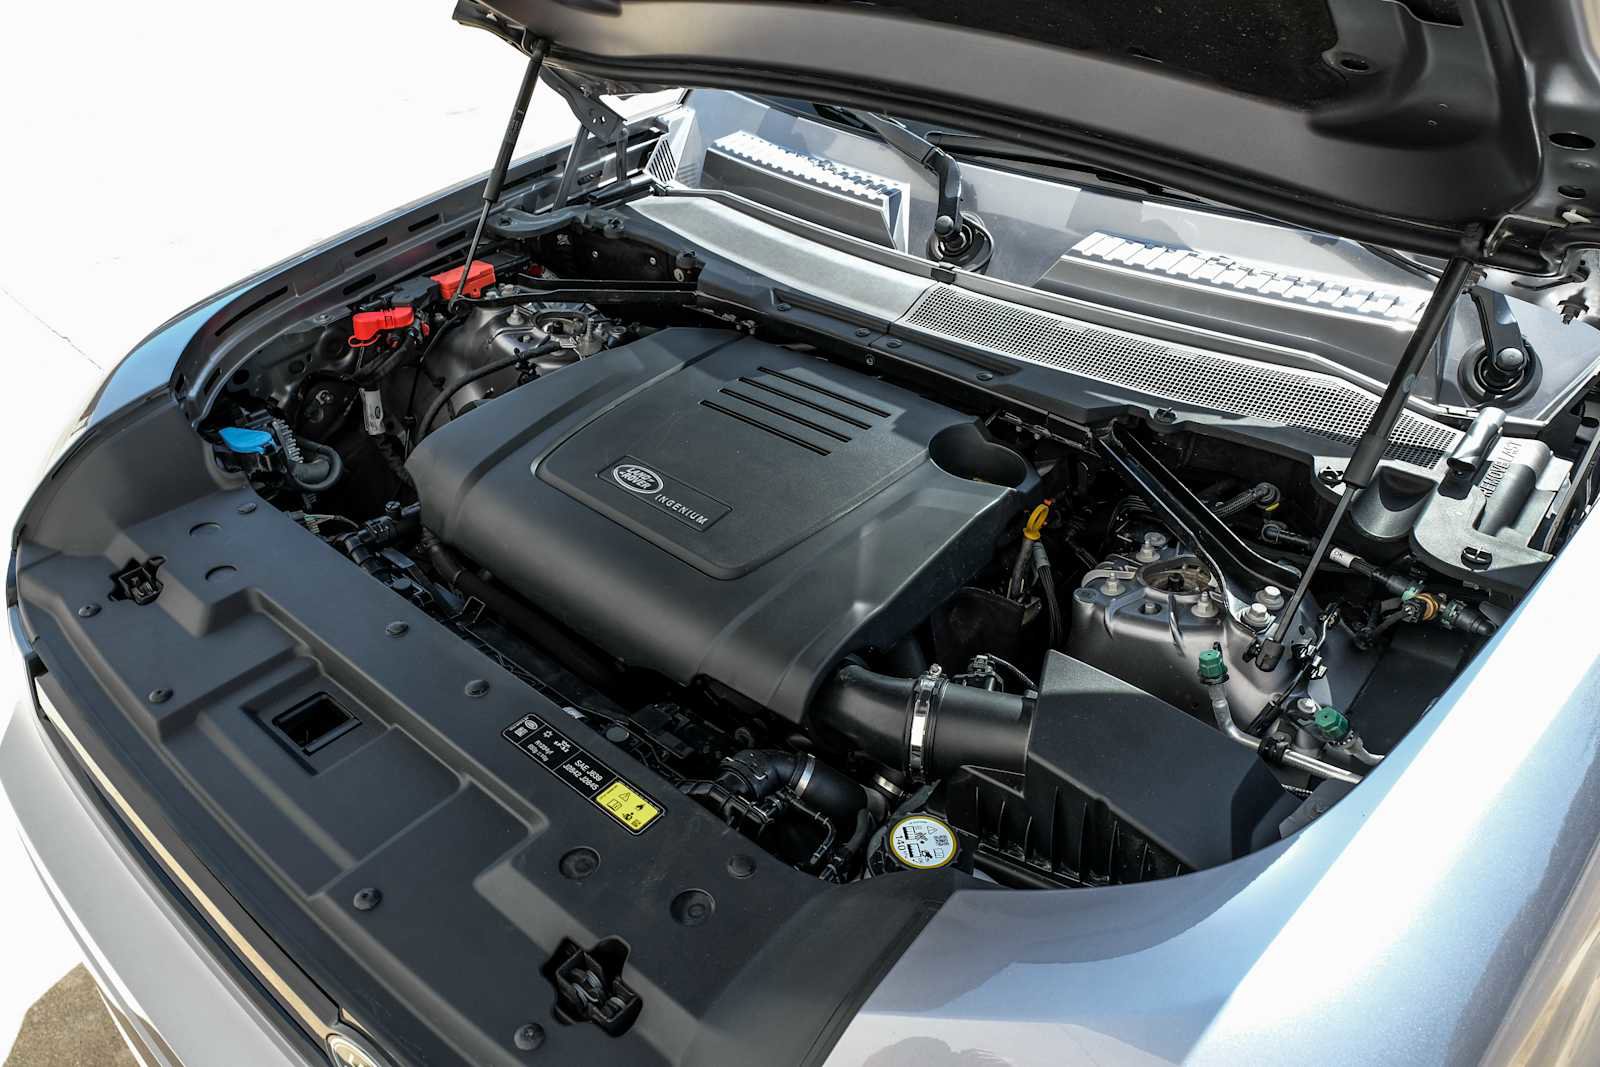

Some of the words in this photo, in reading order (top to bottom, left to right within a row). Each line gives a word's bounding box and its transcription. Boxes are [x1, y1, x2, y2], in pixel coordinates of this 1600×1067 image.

[621, 472, 652, 489] ROVER
[625, 467, 652, 482] LAND
[1479, 461, 1511, 498] REMOVE
[654, 494, 709, 525] INGENIUM
[574, 759, 590, 772] SAE
